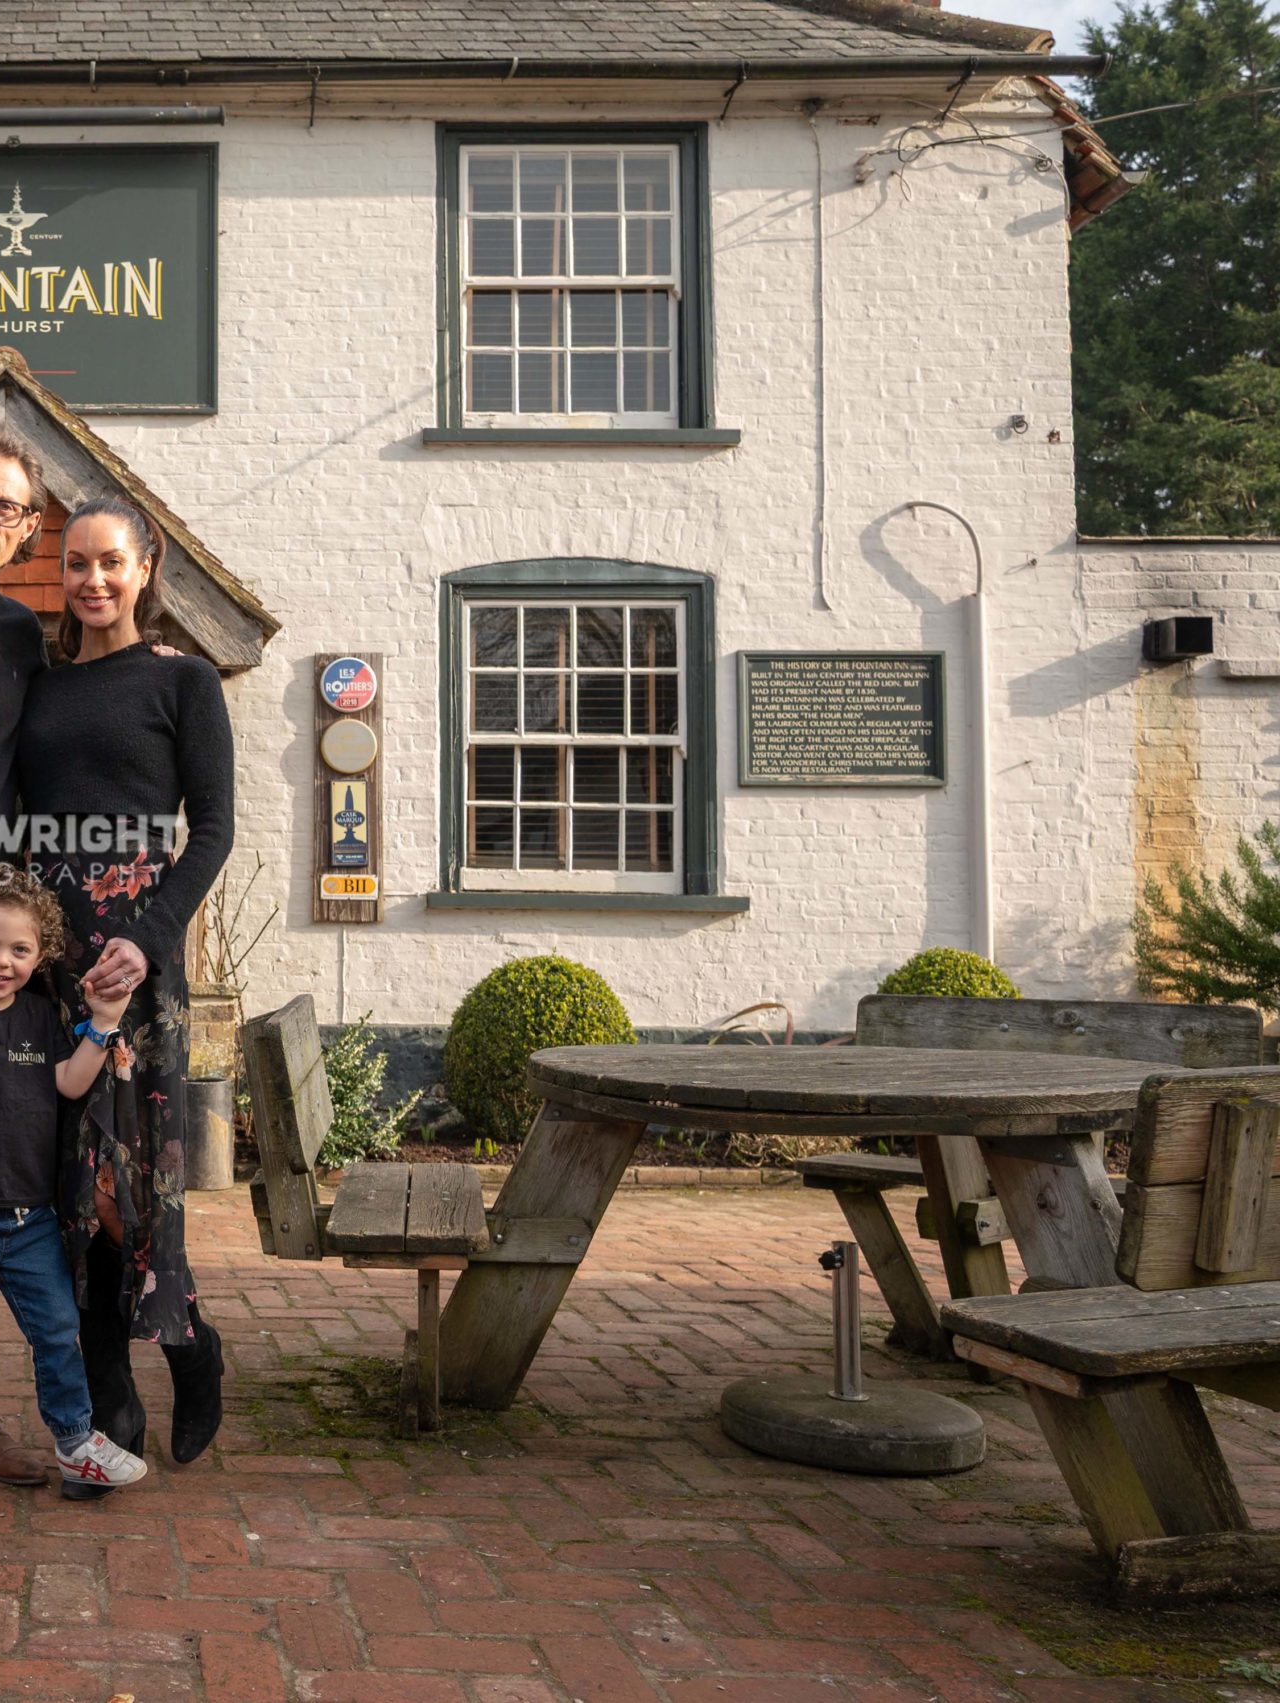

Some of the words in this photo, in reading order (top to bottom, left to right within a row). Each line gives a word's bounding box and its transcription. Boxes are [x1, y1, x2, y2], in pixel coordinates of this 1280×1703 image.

[770, 662, 784, 670] THE
[787, 662, 820, 670] HISTORY
[822, 662, 832, 670] OF
[835, 662, 850, 670] THE
[852, 662, 892, 670] FOUNTAIN
[894, 662, 909, 670] INN
[340, 668, 355, 678] LES
[325, 680, 372, 693] ROUTIERS
[344, 879, 366, 892] BII
